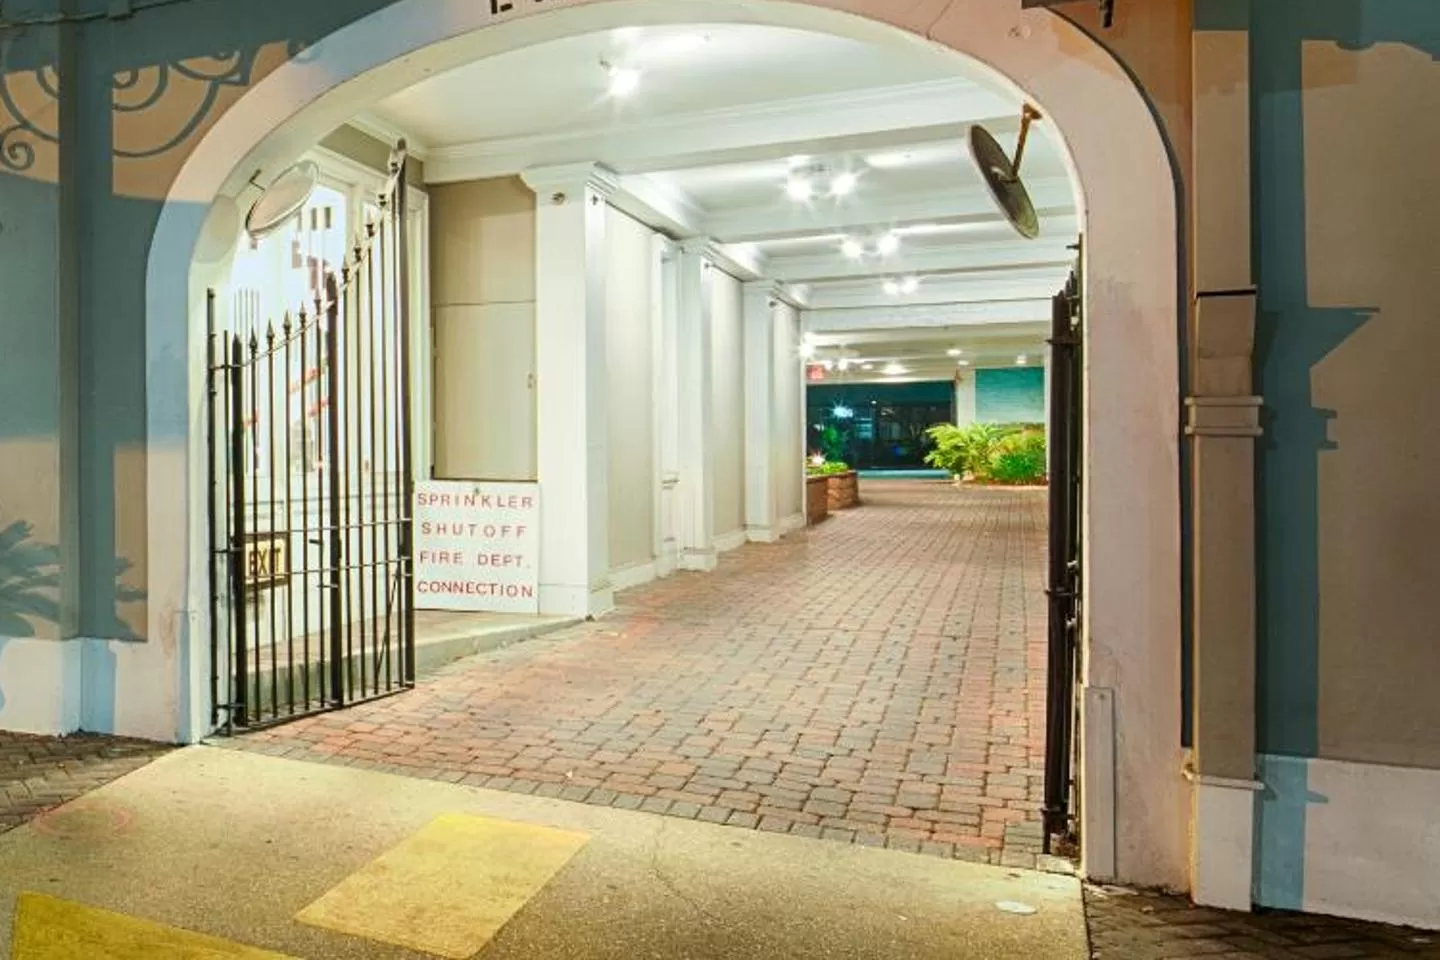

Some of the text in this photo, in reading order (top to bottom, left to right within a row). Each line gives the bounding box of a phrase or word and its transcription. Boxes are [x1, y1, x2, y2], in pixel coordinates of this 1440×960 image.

[417, 493, 533, 509] SPRINKLER
[249, 548, 281, 577] EXT
[420, 551, 464, 565] FIRE
[417, 581, 533, 598] CONNECTION
